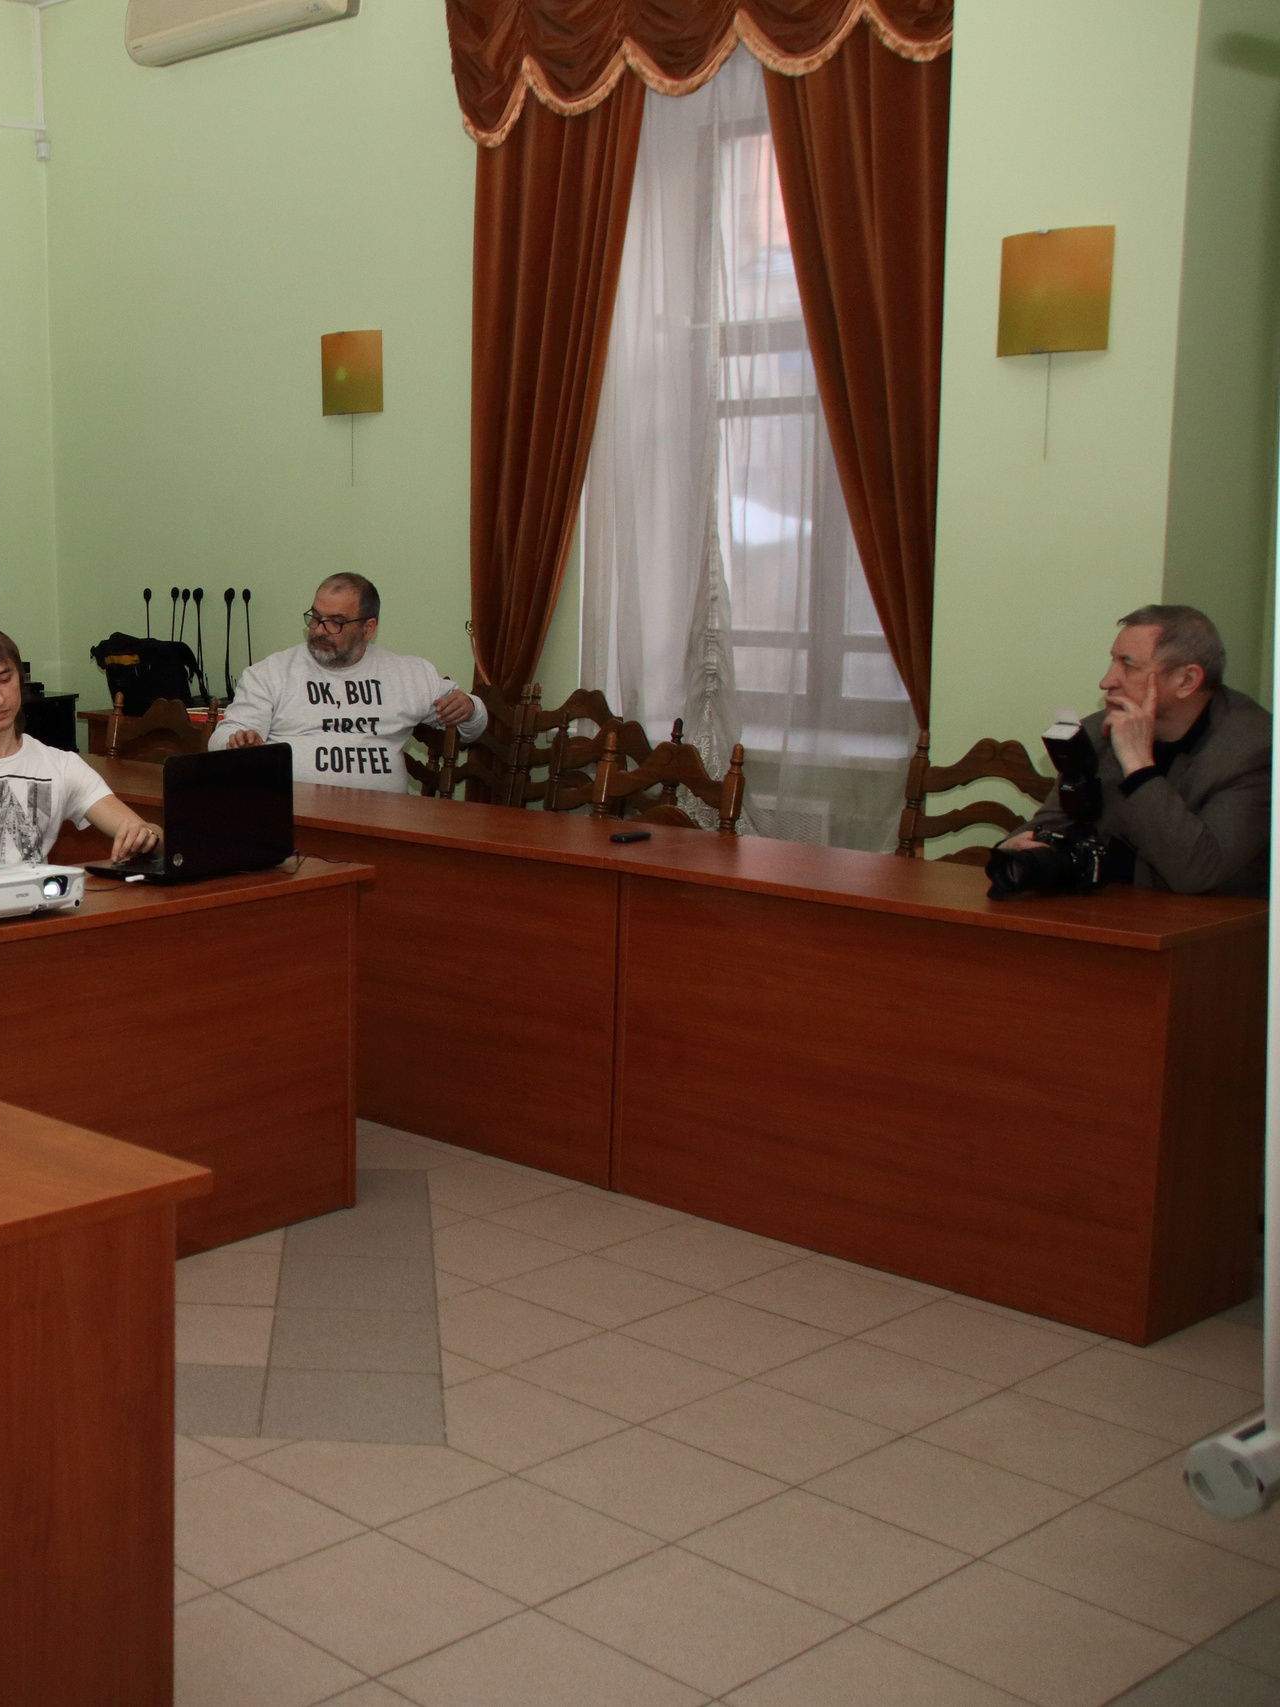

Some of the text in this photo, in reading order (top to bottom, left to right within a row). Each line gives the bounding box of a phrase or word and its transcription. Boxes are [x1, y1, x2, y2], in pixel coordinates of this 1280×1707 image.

[306, 679, 382, 709] OK, BUT
[322, 717, 380, 736] FIRST
[315, 746, 392, 774] COFFEE
